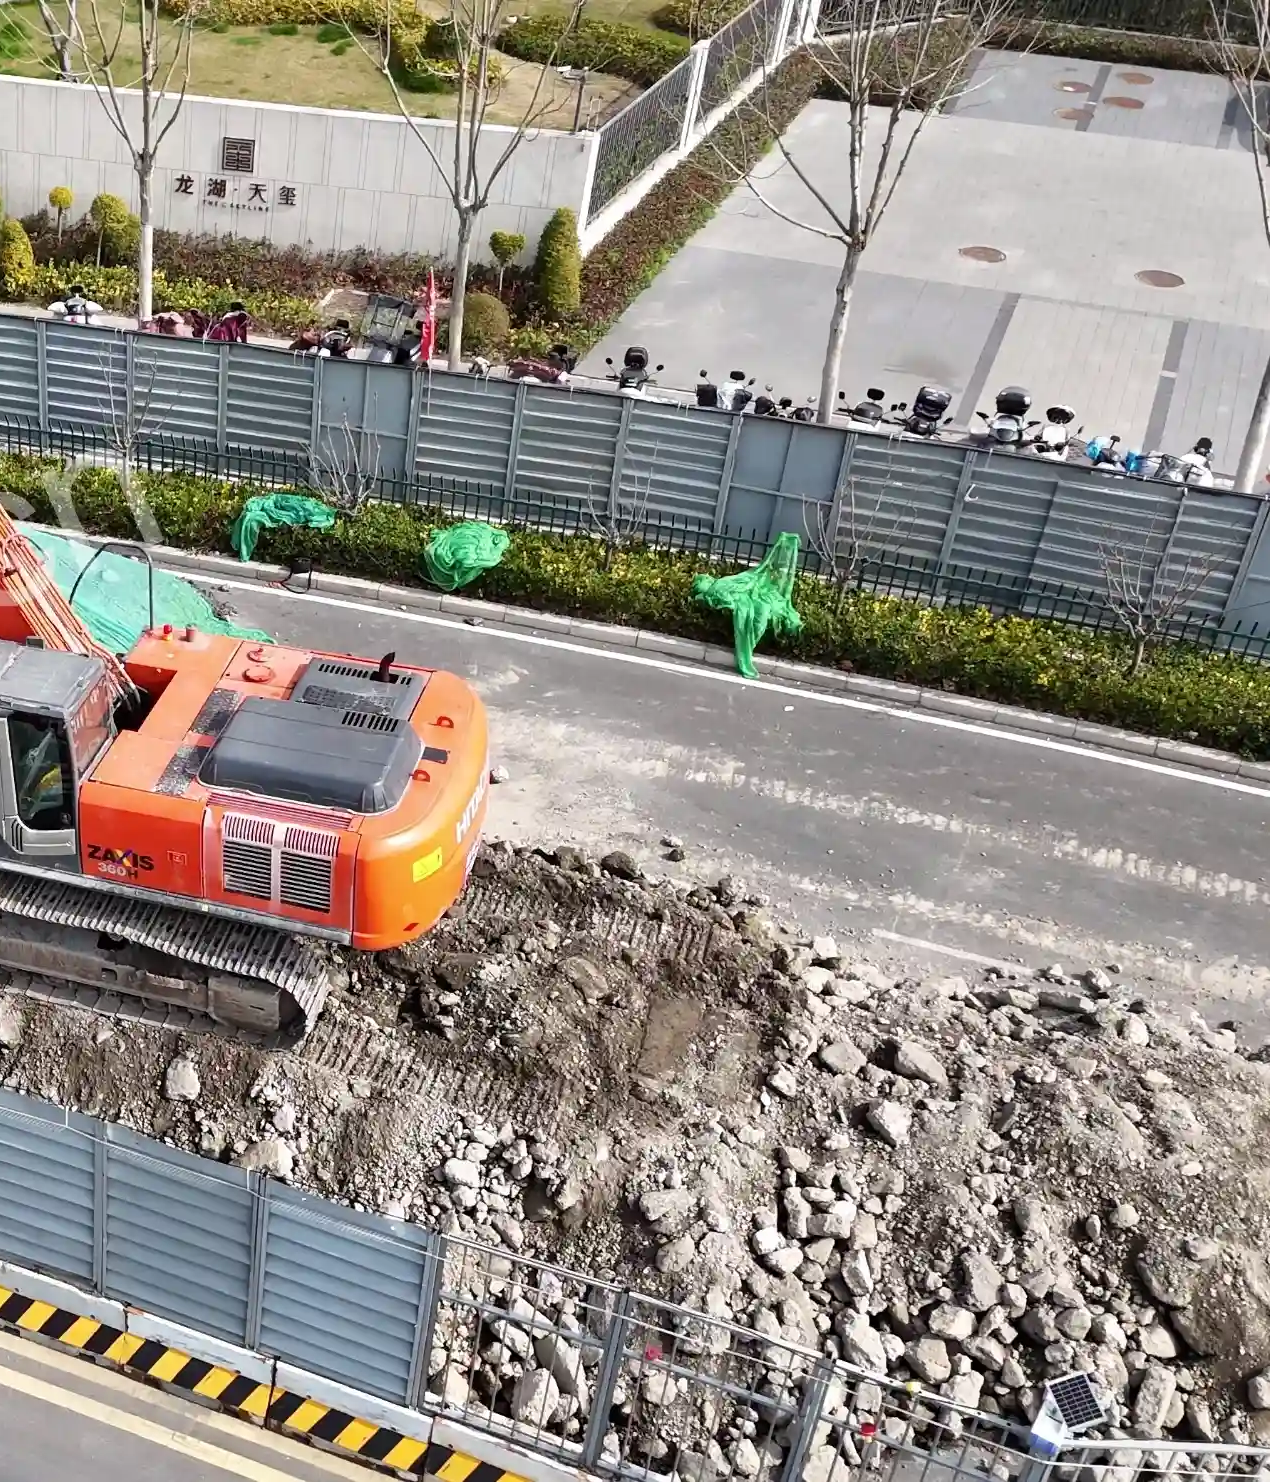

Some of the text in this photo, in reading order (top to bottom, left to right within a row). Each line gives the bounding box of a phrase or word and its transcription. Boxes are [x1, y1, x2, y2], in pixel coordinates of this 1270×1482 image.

[174, 174, 297, 206] 龙湖·天玺
[87, 844, 155, 871] ZAXIS
